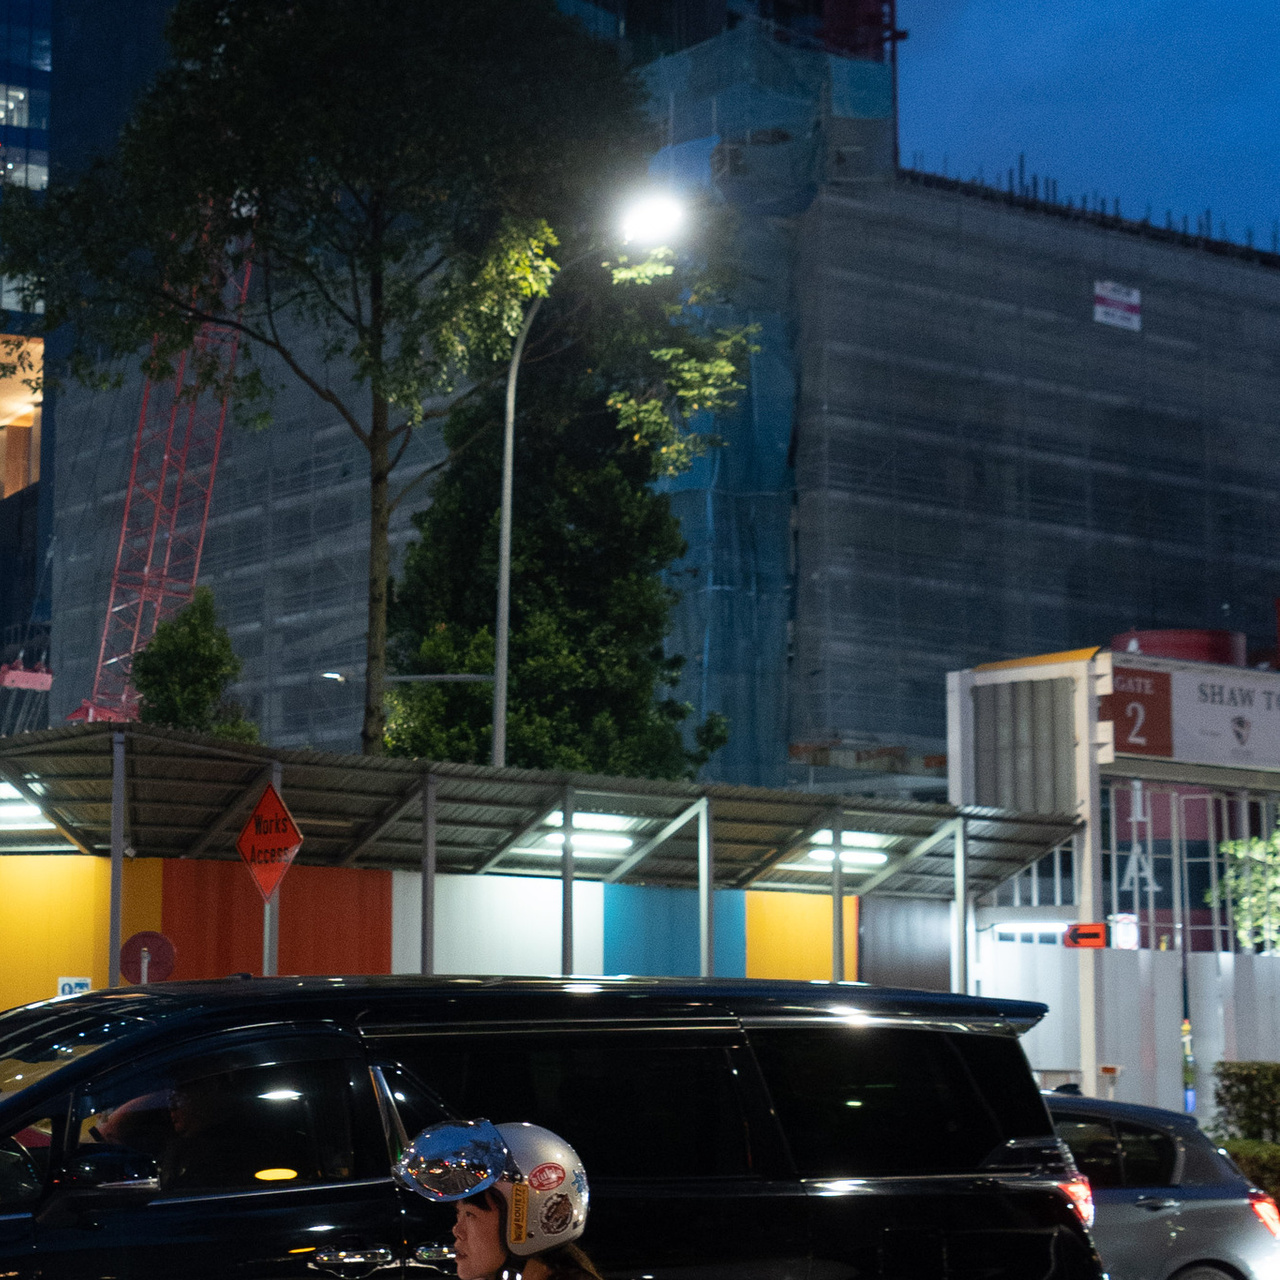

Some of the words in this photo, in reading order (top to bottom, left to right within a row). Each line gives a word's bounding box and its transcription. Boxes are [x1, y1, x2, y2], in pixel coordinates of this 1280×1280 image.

[1113, 676, 1154, 695] GATE
[1197, 682, 1255, 708] SHAW
[1125, 701, 1147, 746] 2
[254, 813, 288, 835] Works
[250, 844, 289, 865] Access
